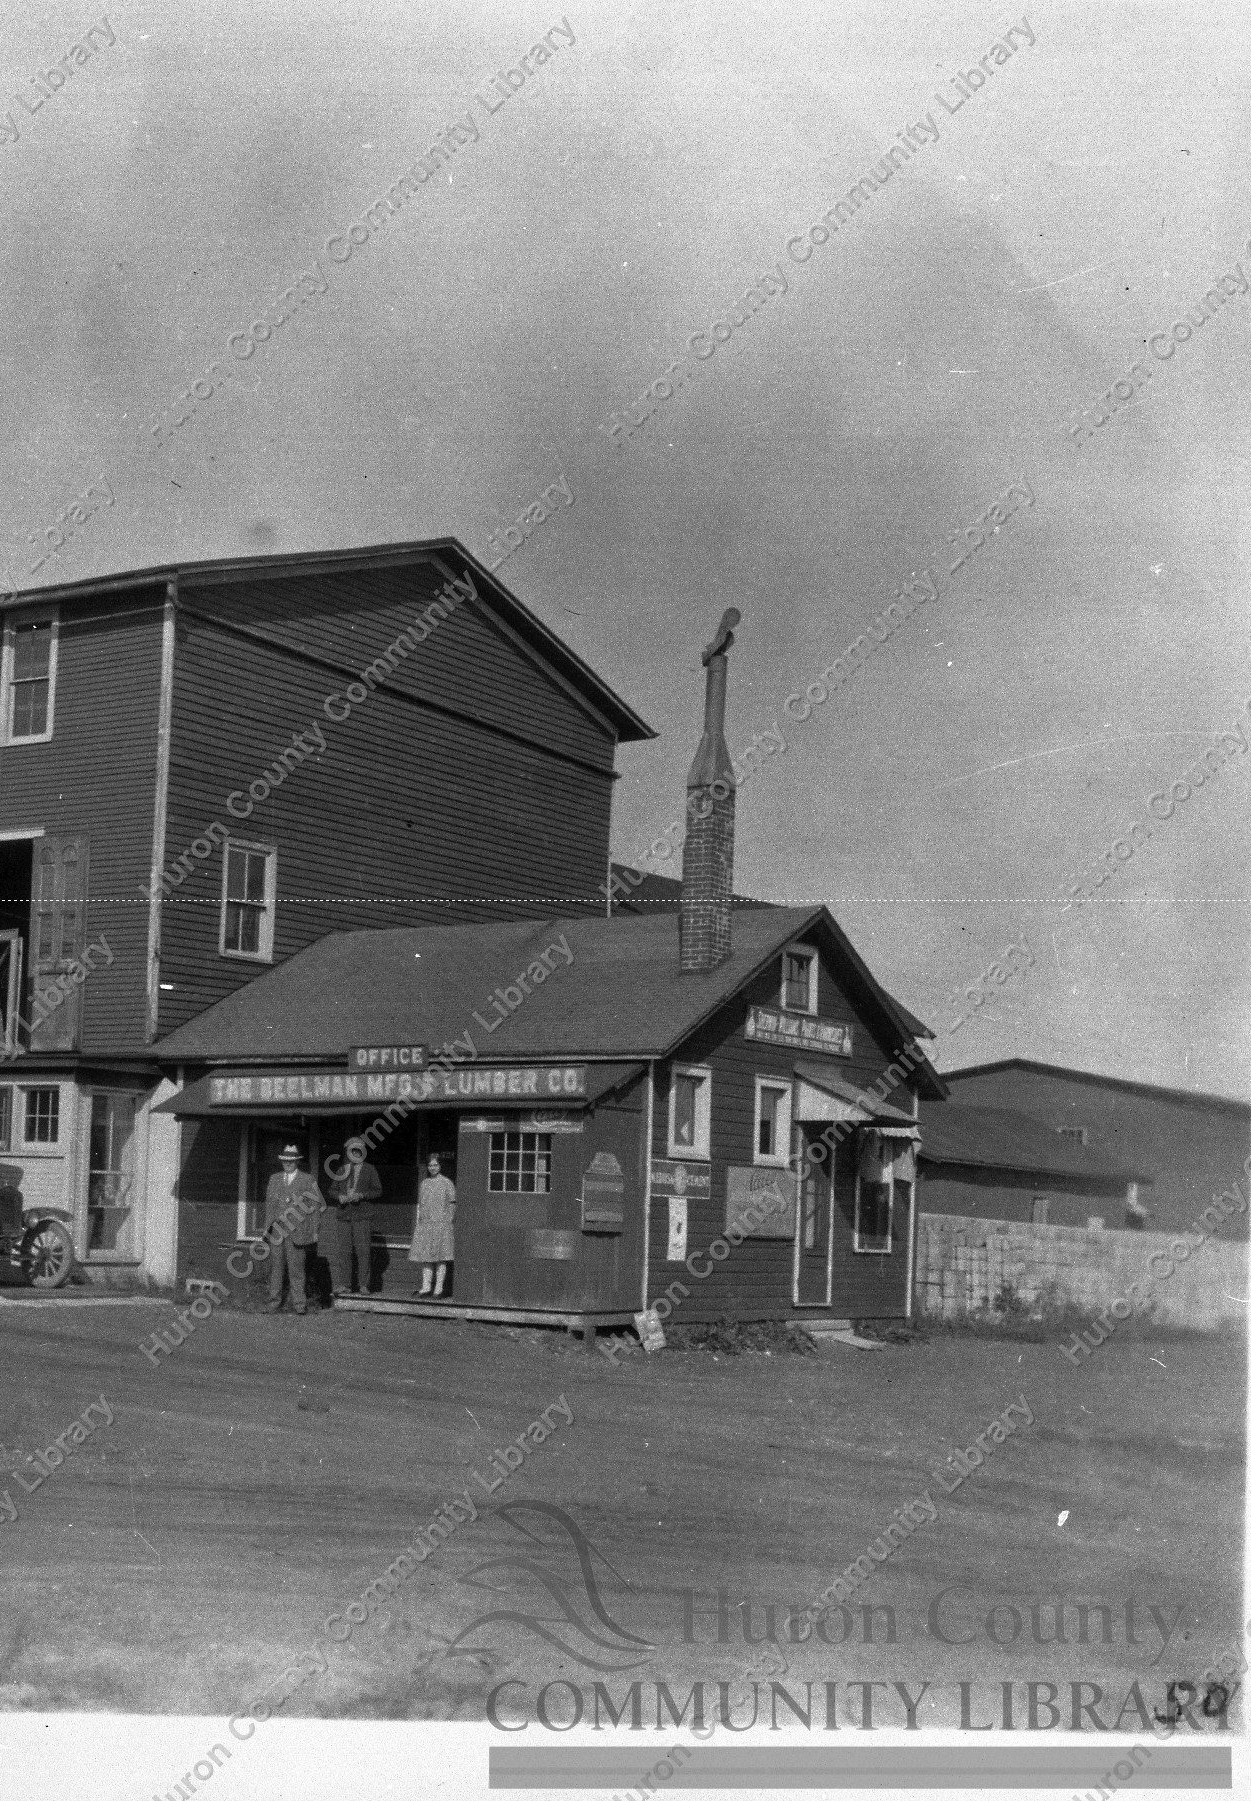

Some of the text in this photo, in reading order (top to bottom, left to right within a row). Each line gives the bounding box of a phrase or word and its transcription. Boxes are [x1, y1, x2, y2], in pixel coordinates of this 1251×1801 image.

[356, 1048, 423, 1067] OFFICE
[214, 1077, 252, 1101] THE
[260, 1074, 358, 1100] BEELMAN
[445, 1070, 538, 1096] LUMBER
[548, 1067, 585, 1094] CO.
